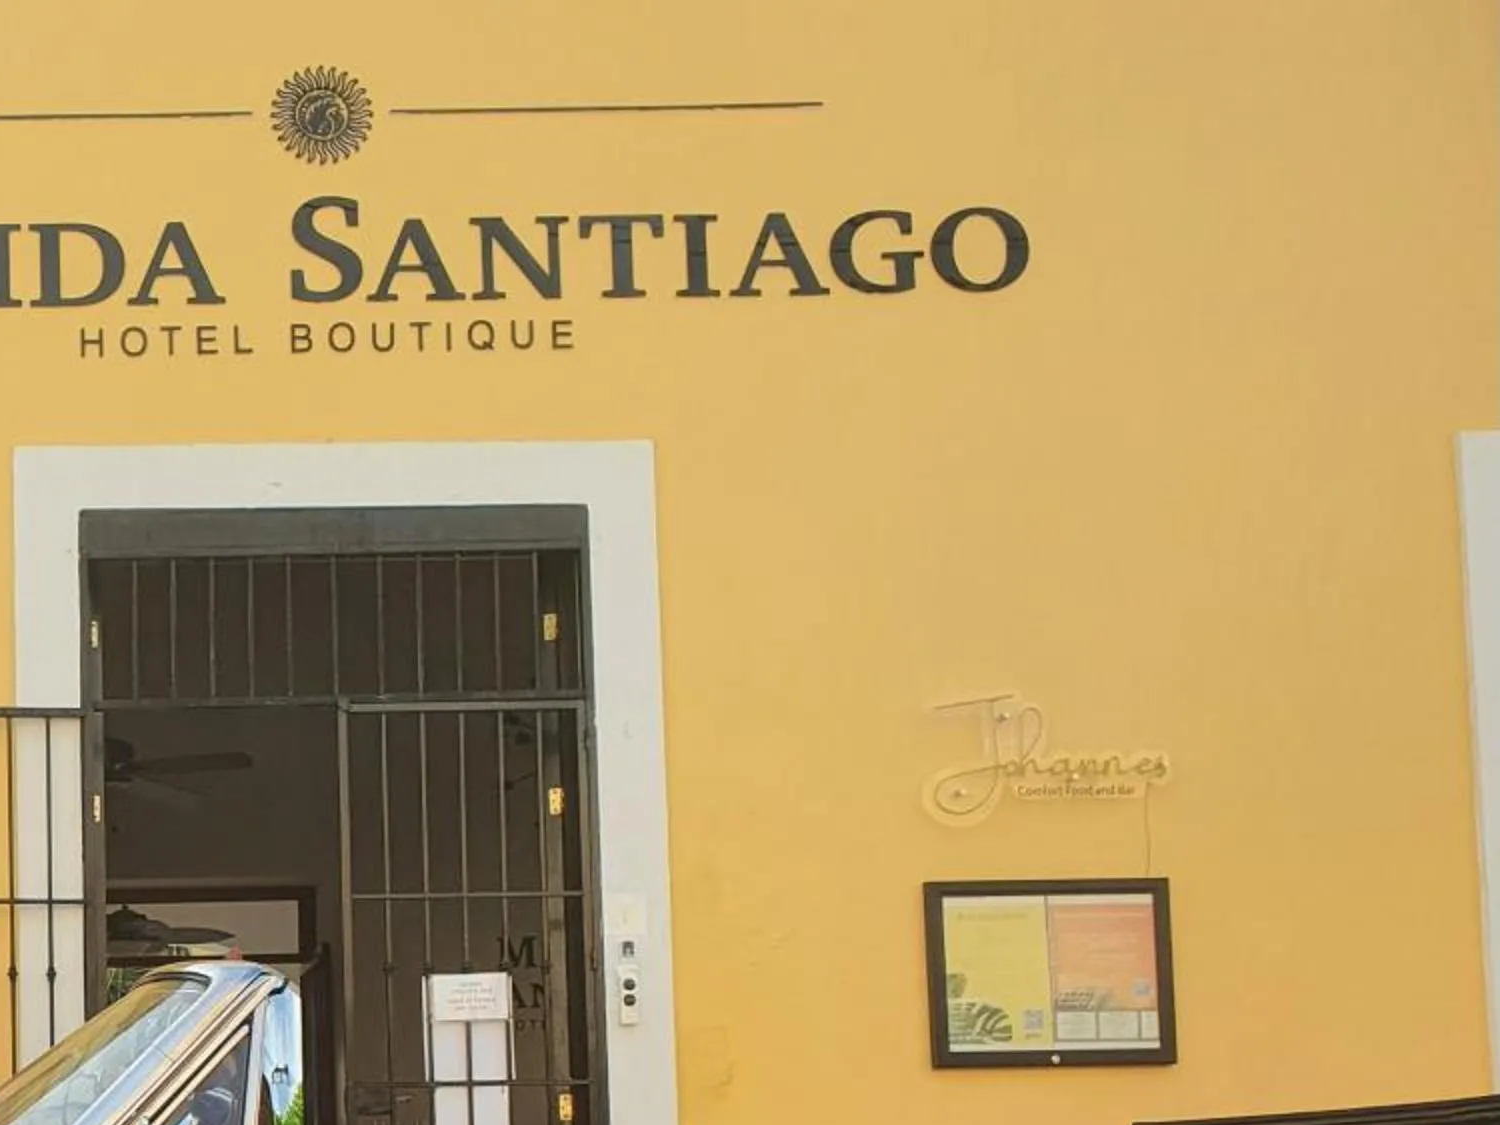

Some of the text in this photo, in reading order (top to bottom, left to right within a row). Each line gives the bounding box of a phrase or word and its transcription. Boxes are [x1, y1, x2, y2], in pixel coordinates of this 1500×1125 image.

[290, 195, 1030, 304] SANTIAGO
[79, 319, 574, 357] HOTEL BOUTIQUE
